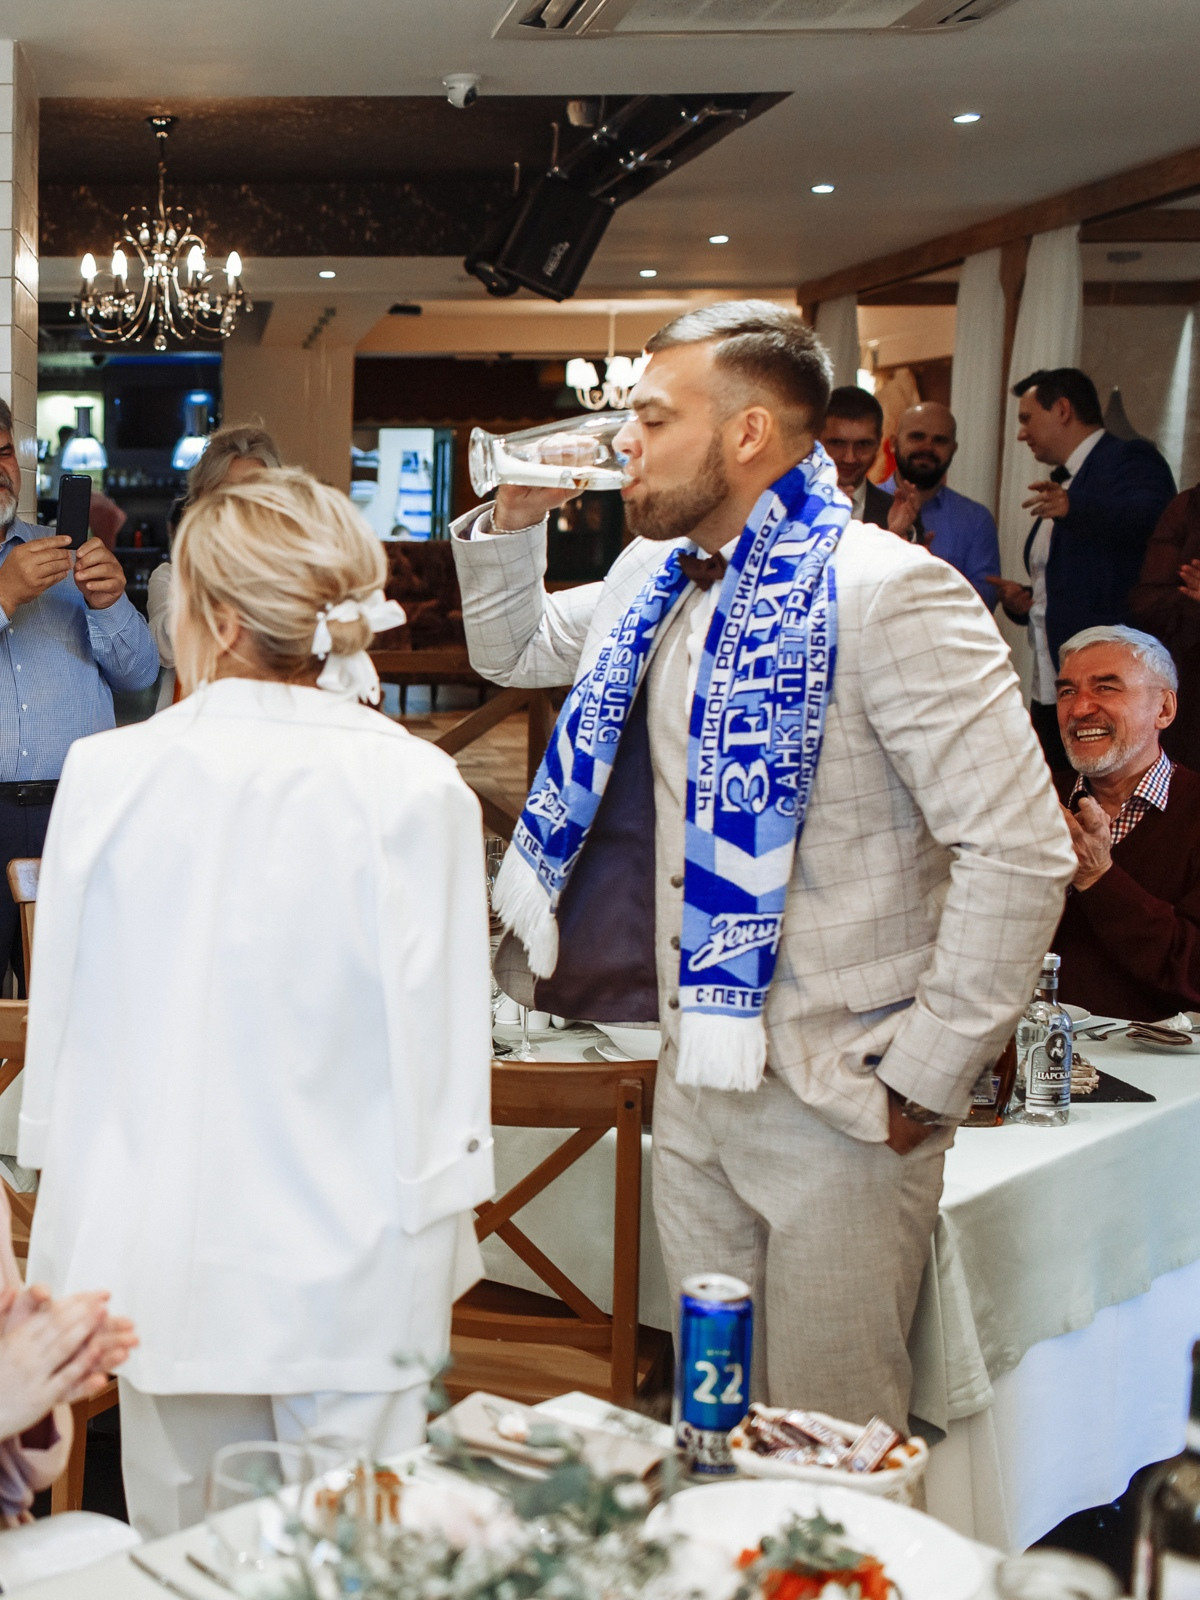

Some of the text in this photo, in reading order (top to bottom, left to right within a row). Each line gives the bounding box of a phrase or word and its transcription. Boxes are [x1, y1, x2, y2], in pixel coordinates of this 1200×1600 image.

[698, 507, 780, 811] ЧЕМПИОН РОССИИ 2007
[720, 524, 821, 814] ЗЕНИТ
[810, 607, 826, 673] КУБКА
[578, 691, 601, 747] 2007
[693, 1360, 743, 1405] 22
